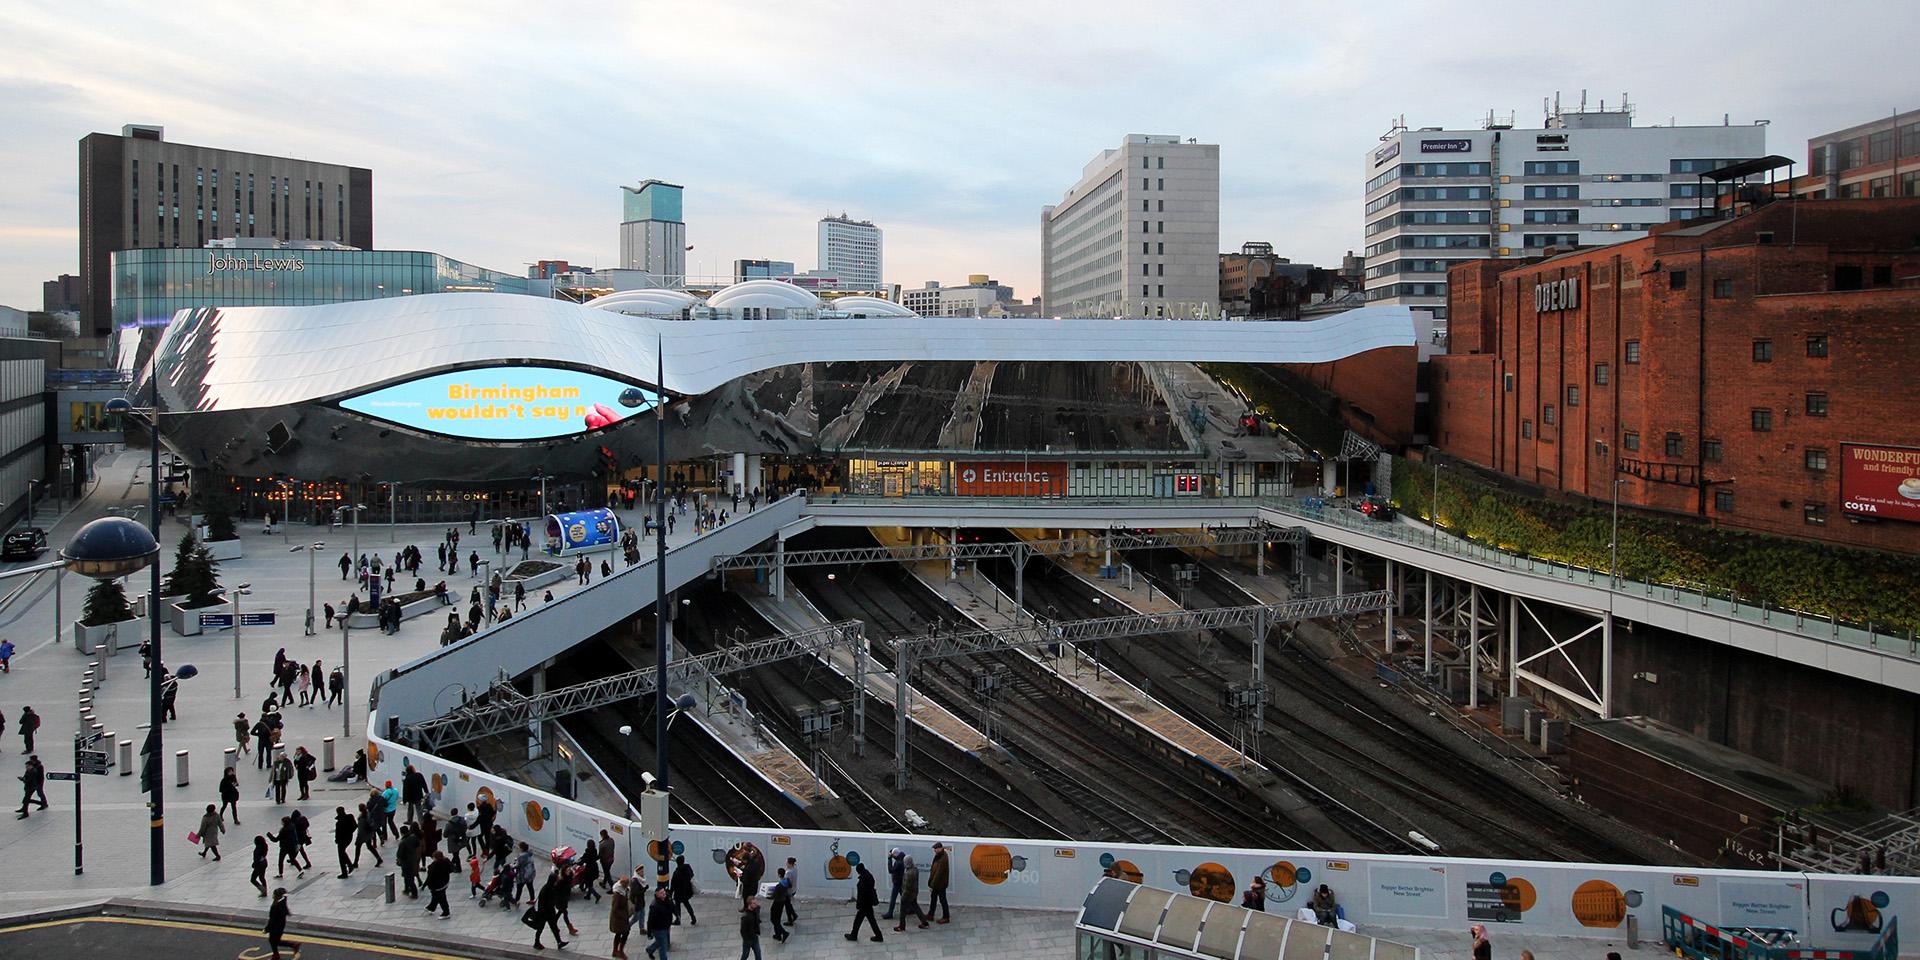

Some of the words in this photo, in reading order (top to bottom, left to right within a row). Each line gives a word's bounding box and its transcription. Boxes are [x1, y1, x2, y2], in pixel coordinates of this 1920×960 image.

[208, 252, 248, 275] John
[253, 253, 305, 271] Lewis
[1535, 277, 1578, 312] ODEON
[1141, 300, 1222, 320] CENTRAL
[448, 383, 580, 402] Birmingham
[427, 403, 526, 419] wouldn't
[531, 405, 570, 421] say
[983, 469, 1050, 483] Entrance
[1863, 463, 1880, 471] and
[1881, 464, 1915, 476] friendly
[426, 494, 453, 502] BAR
[463, 493, 490, 501] ONE
[1844, 501, 1877, 512] COSTA
